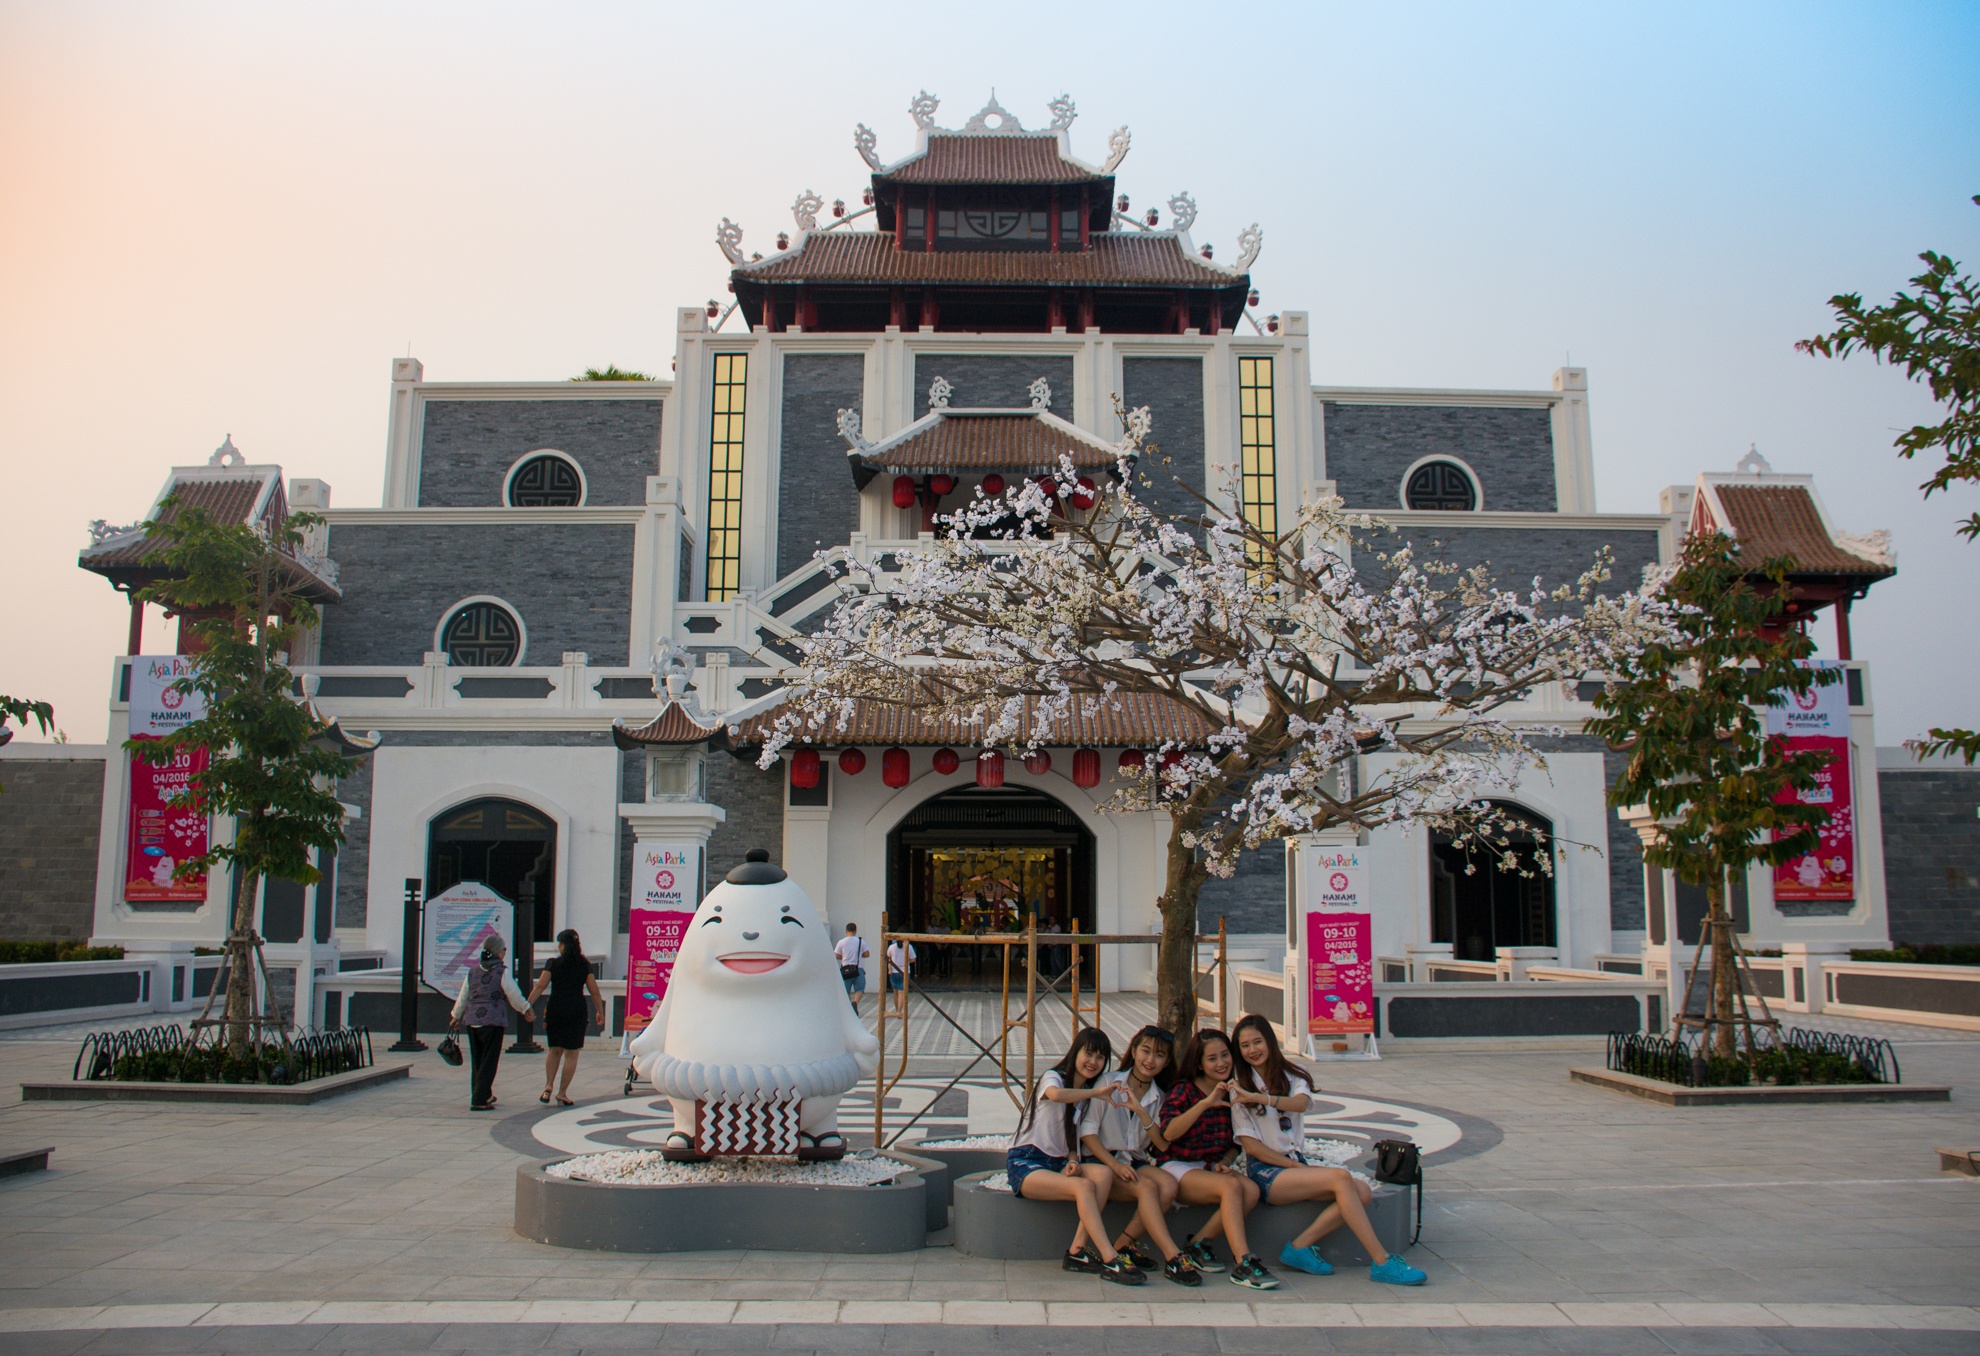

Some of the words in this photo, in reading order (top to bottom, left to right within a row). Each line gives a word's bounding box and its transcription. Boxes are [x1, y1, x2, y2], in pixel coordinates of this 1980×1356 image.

[148, 659, 171, 679] Asia
[151, 711, 191, 720] HANAMI
[1788, 713, 1828, 721] HANAMI
[152, 772, 190, 783] 04/2016
[645, 851, 663, 866] Asia
[665, 851, 686, 865] Park
[1318, 854, 1337, 869] Asia
[1337, 853, 1359, 867] Park
[647, 891, 682, 899] HANAMI
[646, 925, 679, 936] 09-10
[1323, 927, 1357, 939] 09-10
[646, 939, 679, 947] 04/2016
[1324, 940, 1358, 950] 04/2016
